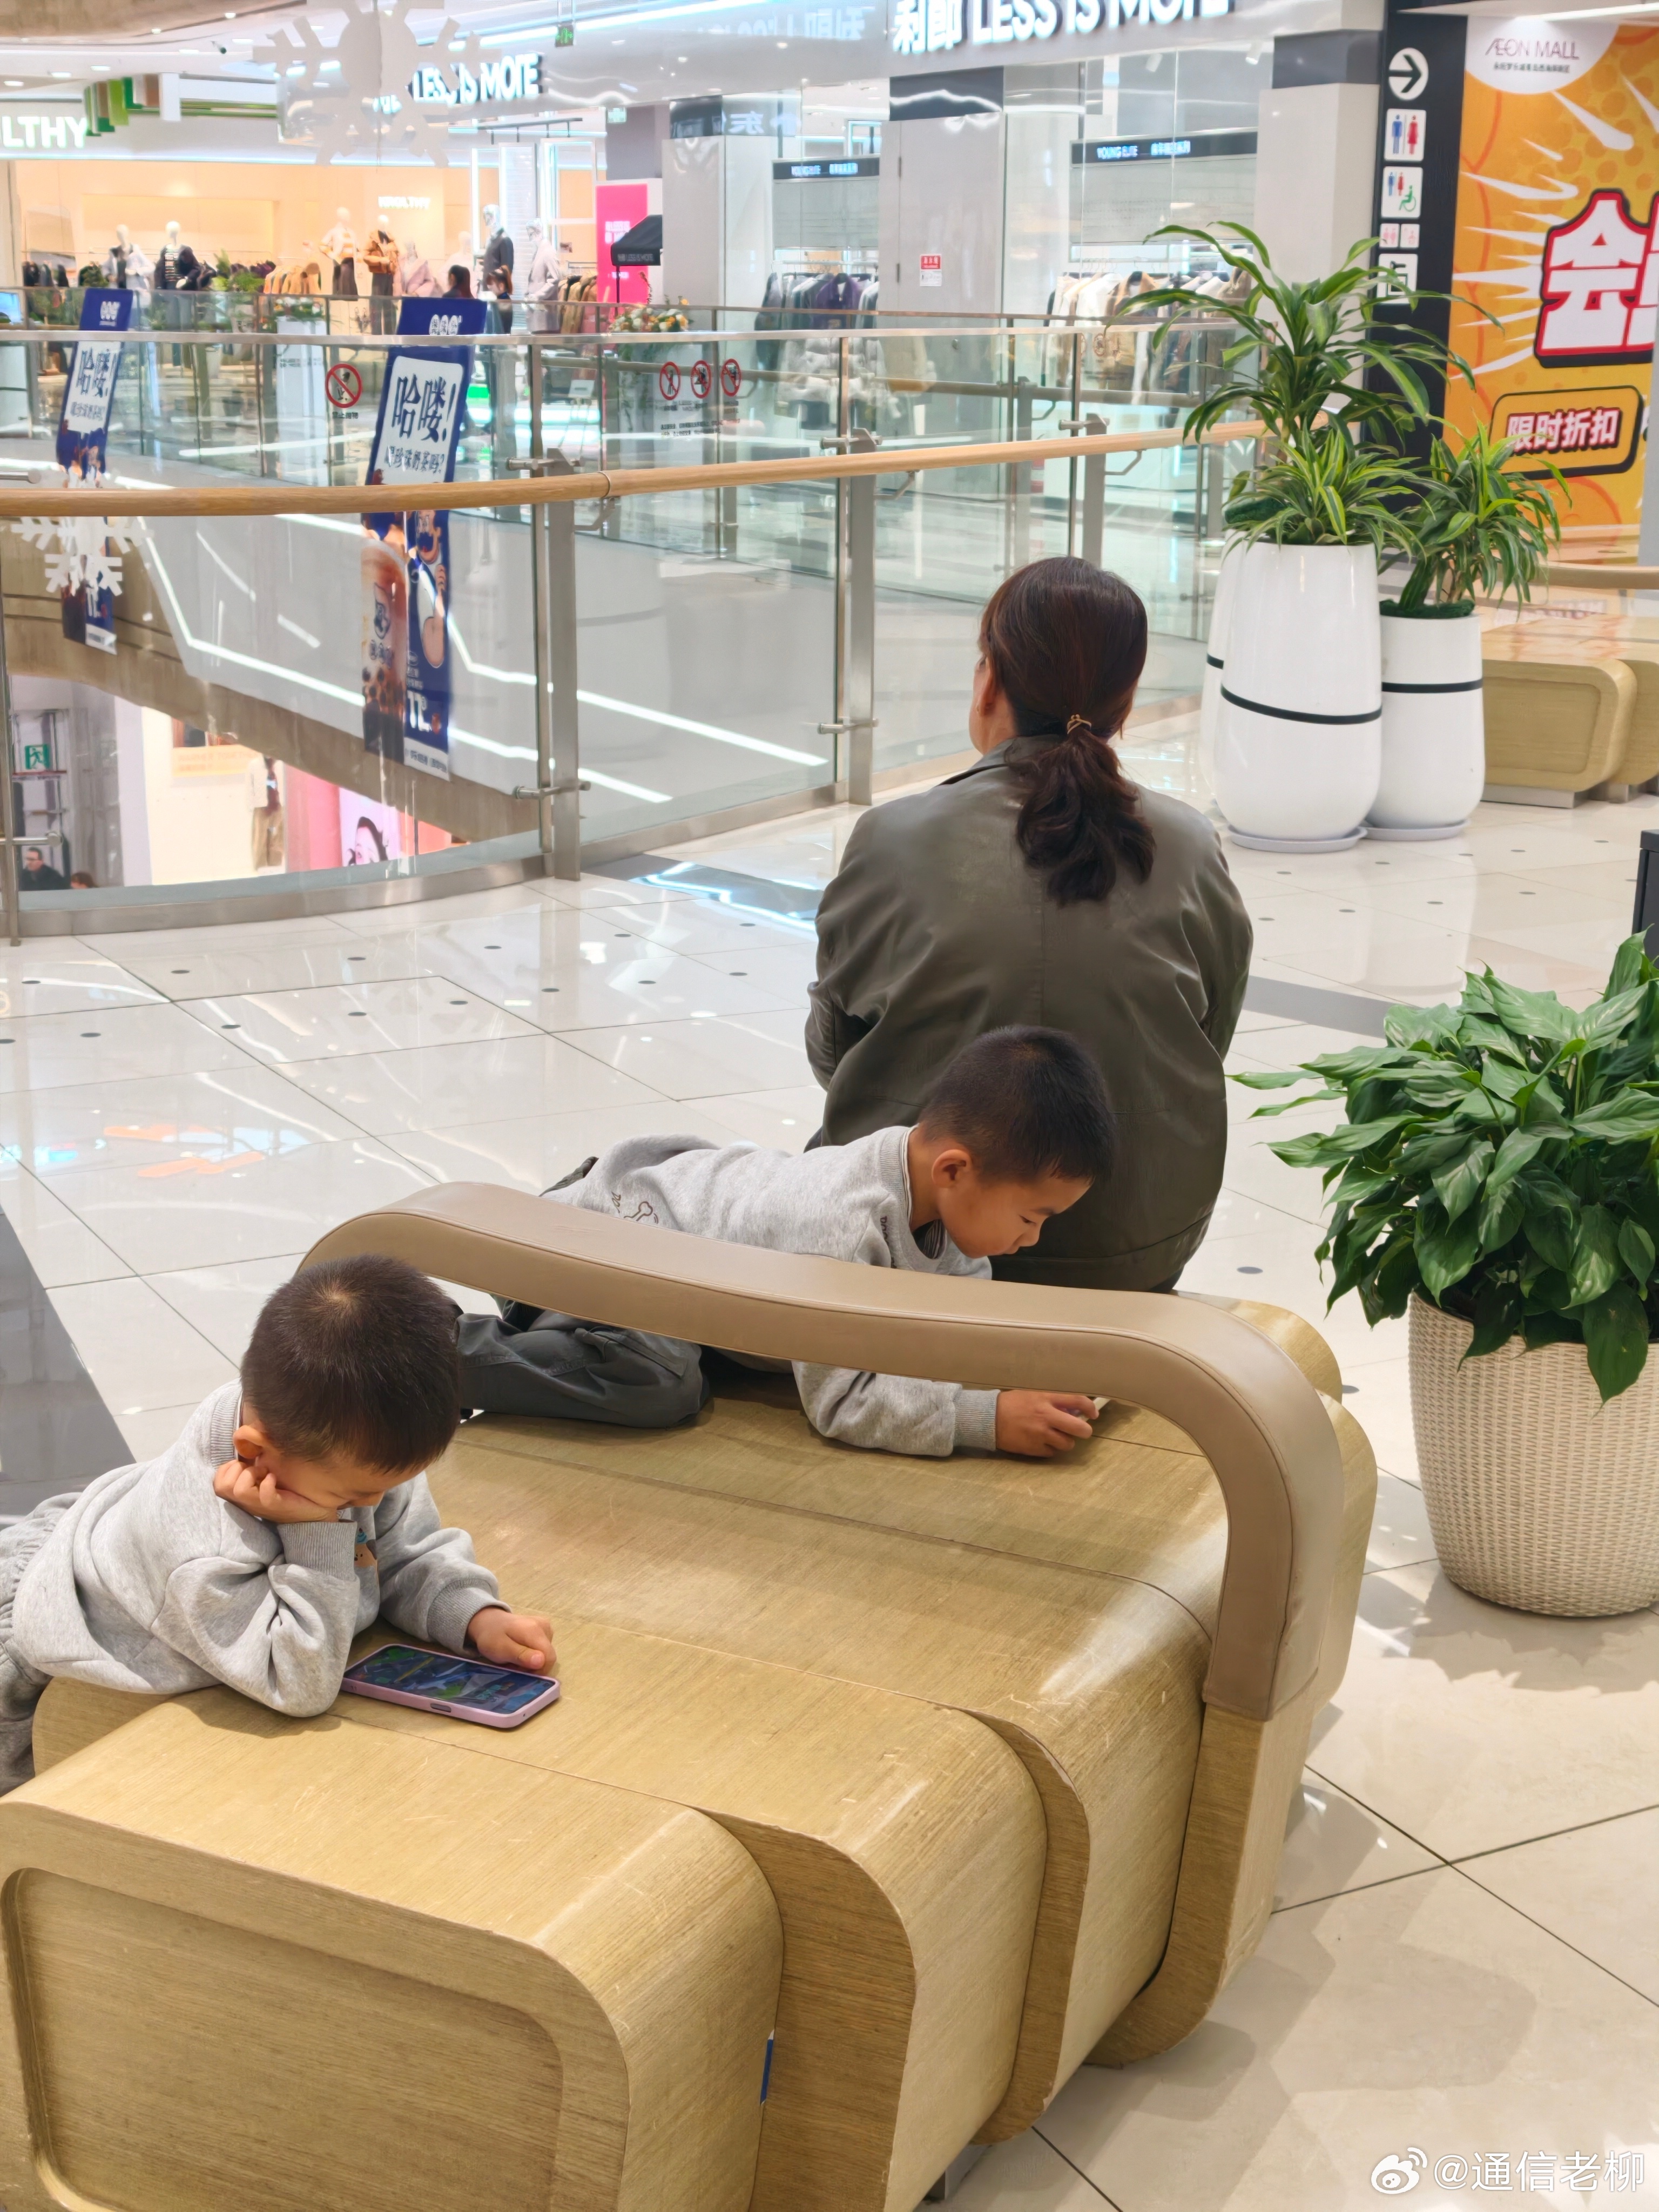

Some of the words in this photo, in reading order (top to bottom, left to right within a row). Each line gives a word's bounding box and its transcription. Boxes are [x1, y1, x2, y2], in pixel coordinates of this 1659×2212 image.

[973, 0, 1057, 43] LESS
[1535, 40, 1580, 59] MALL
[392, 373, 457, 443] 哈喽!
[1506, 406, 1622, 455] 限时折扣
